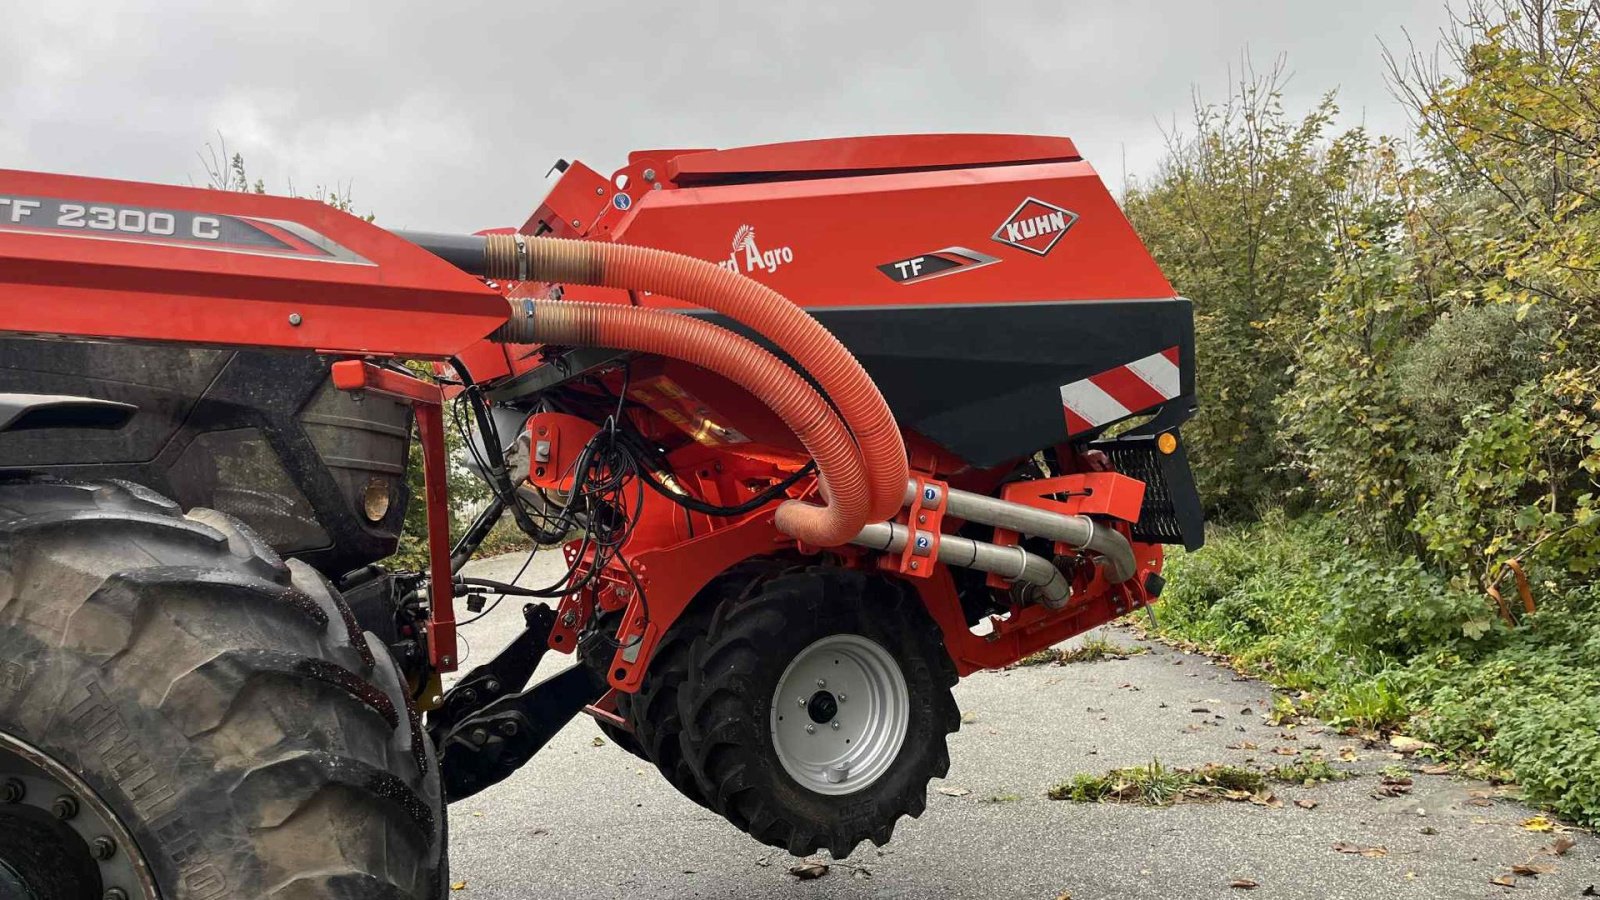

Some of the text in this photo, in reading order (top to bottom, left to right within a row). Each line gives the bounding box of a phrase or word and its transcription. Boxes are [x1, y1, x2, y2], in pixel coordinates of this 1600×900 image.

[57, 203, 175, 235] 2300
[192, 216, 220, 240] C
[1006, 211, 1067, 242] KUHN
[744, 236, 793, 274] Agro
[894, 257, 925, 279] TF
[66, 680, 232, 900] TRELLEBO
